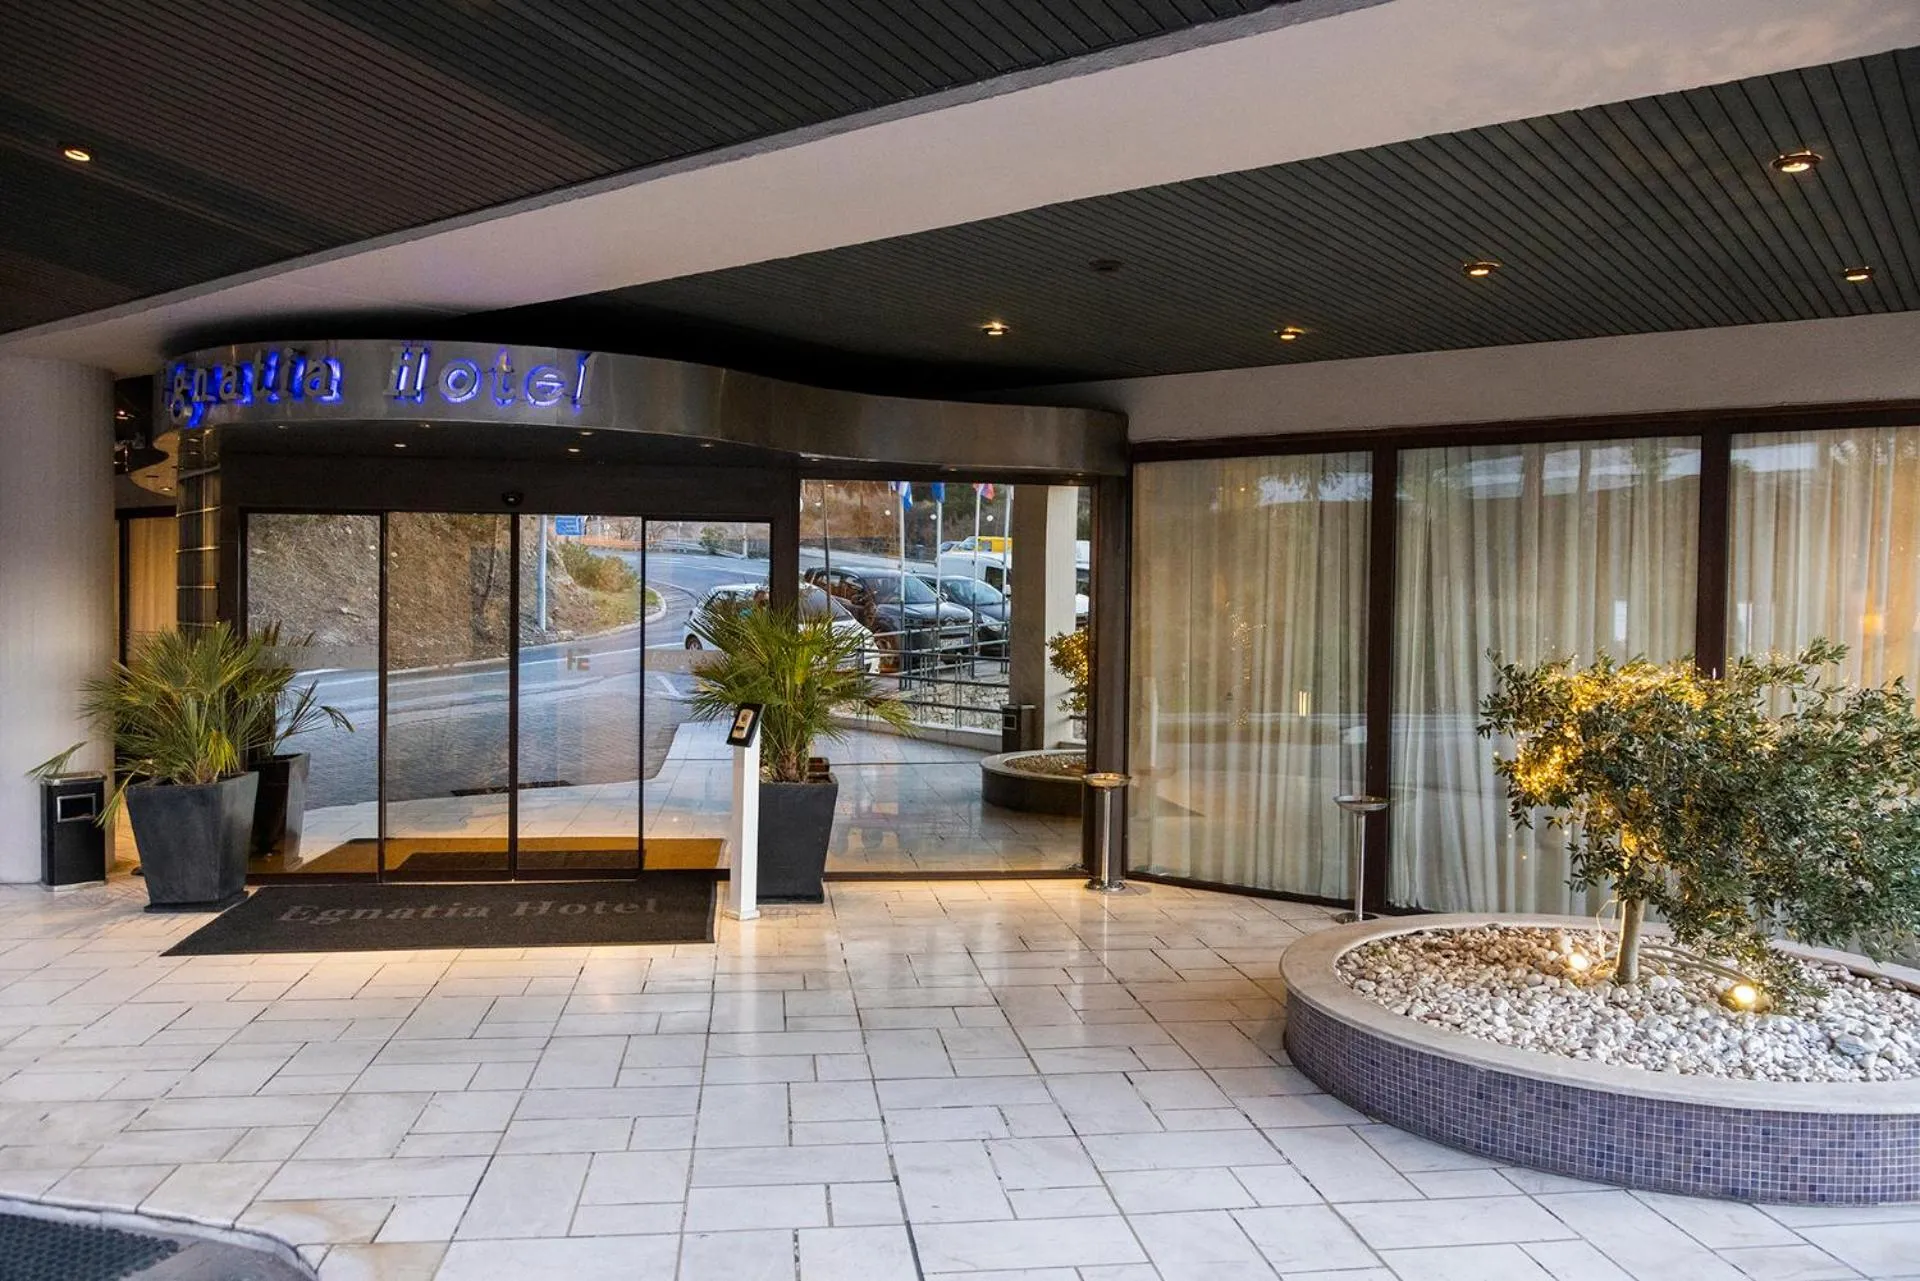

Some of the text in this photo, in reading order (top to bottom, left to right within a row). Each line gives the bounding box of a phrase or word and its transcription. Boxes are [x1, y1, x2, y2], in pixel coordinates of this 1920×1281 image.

[165, 345, 597, 427] gnatia Hotel
[276, 899, 658, 925] Egnatia Hotel
